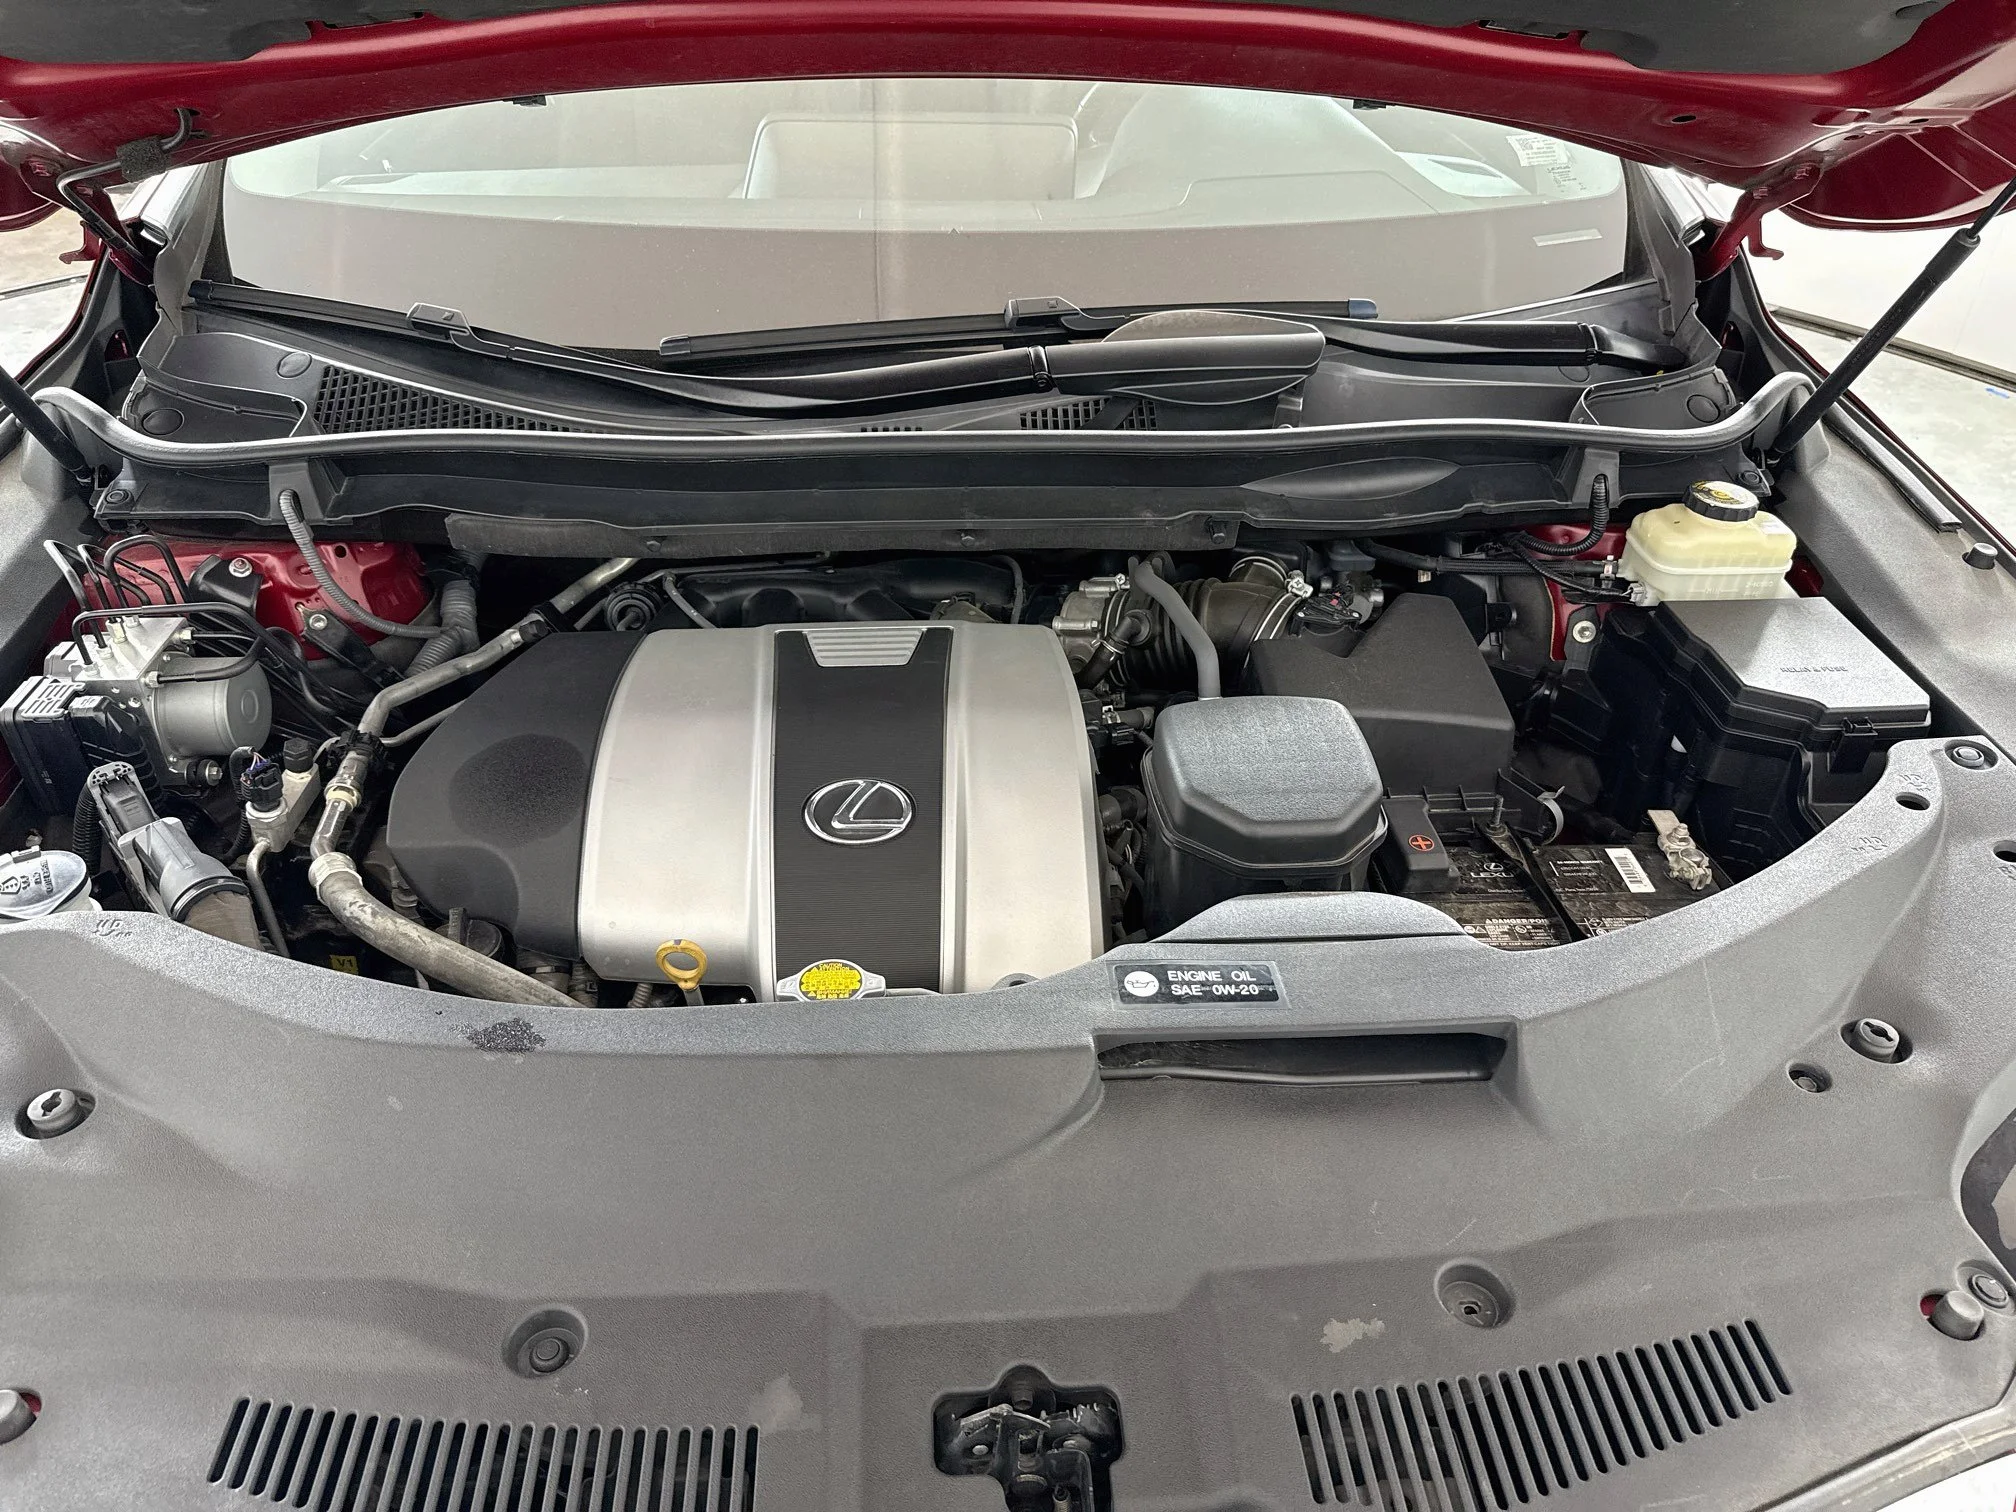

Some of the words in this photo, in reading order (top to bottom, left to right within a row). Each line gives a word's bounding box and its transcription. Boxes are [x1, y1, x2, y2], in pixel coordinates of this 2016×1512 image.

[1167, 970, 1222, 982] ENGINE
[1231, 970, 1256, 981] OIL
[1171, 984, 1203, 995] SAE
[1212, 984, 1259, 995] 0W-20
